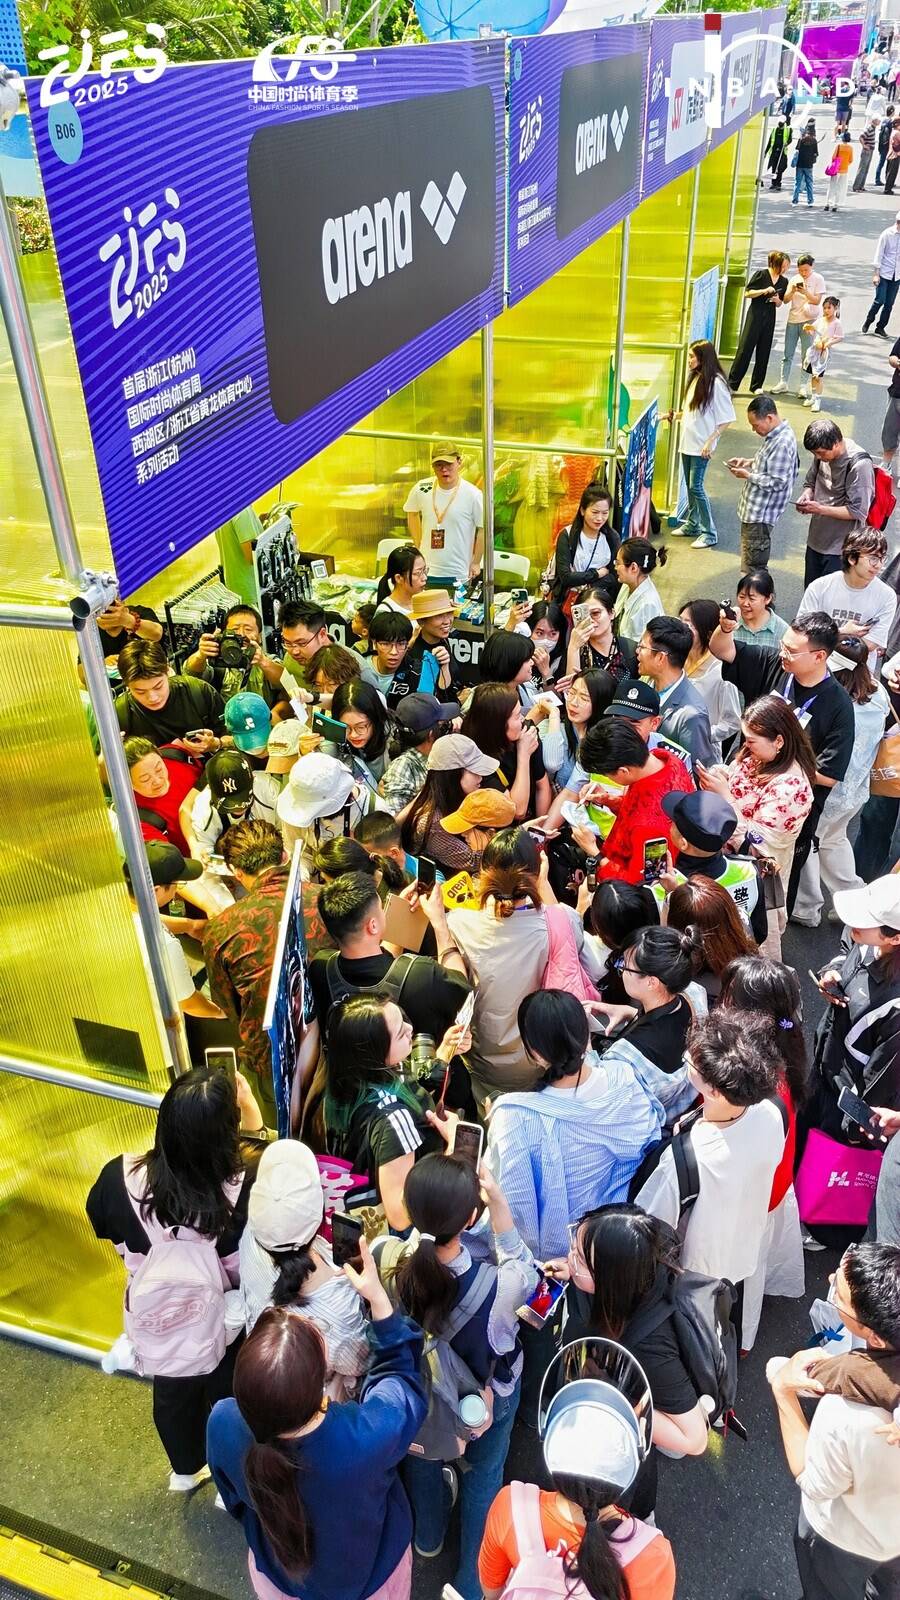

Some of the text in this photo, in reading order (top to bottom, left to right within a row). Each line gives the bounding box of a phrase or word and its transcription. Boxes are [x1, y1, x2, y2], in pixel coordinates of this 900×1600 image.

[55, 122, 77, 140] B06
[575, 113, 609, 176] arena
[321, 190, 413, 305] arena
[134, 265, 169, 320] 2025
[122, 346, 196, 400] 首届浙江(杭州)
[127, 373, 202, 430] 国际时尚体育周
[131, 374, 253, 458] 西湖区/浙江省黄龙体育中心
[135, 443, 180, 485] 系列活动
[832, 608, 862, 622] FREE
